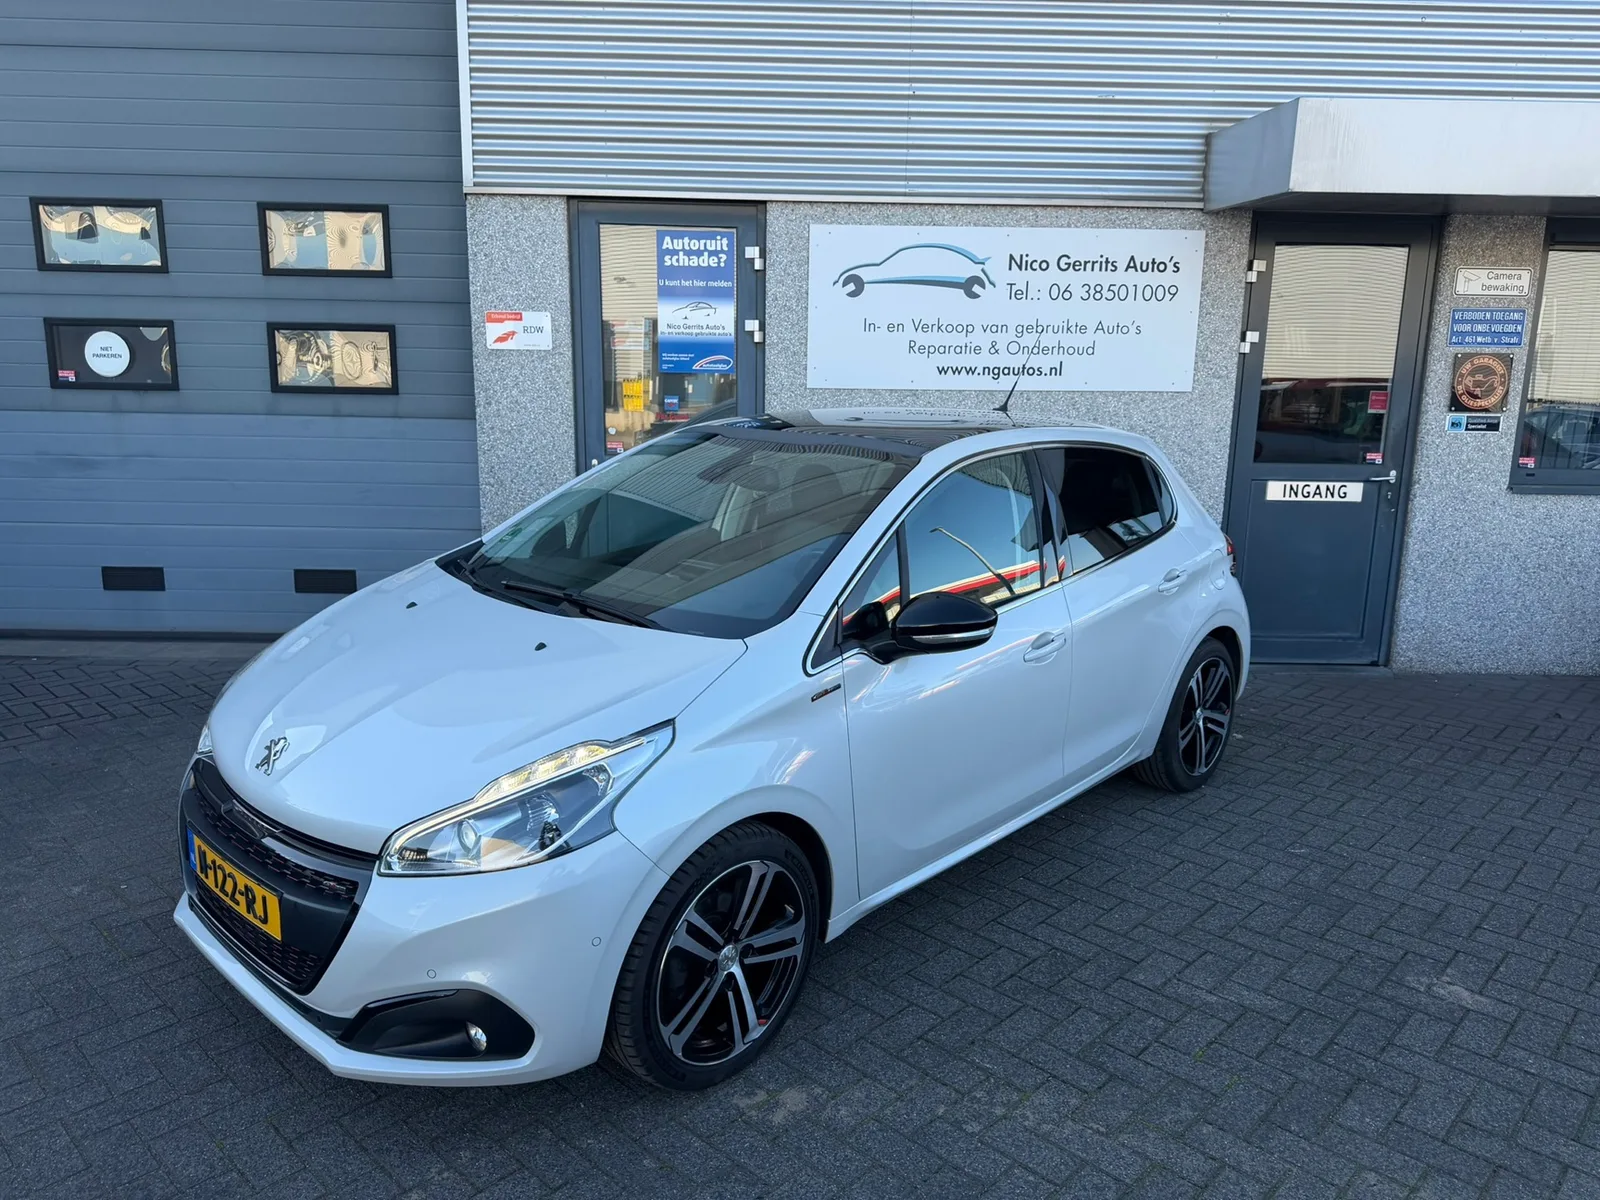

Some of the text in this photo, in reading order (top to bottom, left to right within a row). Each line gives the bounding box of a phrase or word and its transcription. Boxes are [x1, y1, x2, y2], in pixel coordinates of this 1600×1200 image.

[662, 235, 729, 251] Autoruit
[664, 251, 727, 267] schade?
[1008, 253, 1181, 273] Nico Gerrits Auto's
[681, 279, 693, 287] het
[693, 279, 706, 287] hier
[1486, 271, 1522, 280] Camera
[1006, 280, 1179, 301] Tel.: 06 38501009
[1481, 282, 1525, 294] bewaking
[1454, 311, 1524, 321] VERBODEN TOEGANG
[522, 325, 544, 334] RDW
[705, 323, 726, 331] Auto's
[863, 317, 1142, 338] In- en Verkoop van gebruikte Auto's
[1453, 323, 1522, 333] VOOR ONBEVOEGDEN
[908, 340, 1096, 358] Reparatie & Onderhoud
[936, 361, 1063, 380] www.ngautos.nl
[1461, 357, 1505, 375] UW GARAGIST
[1457, 385, 1504, 407] DE OLIESPECIALIST
[1282, 484, 1348, 499] INGANG
